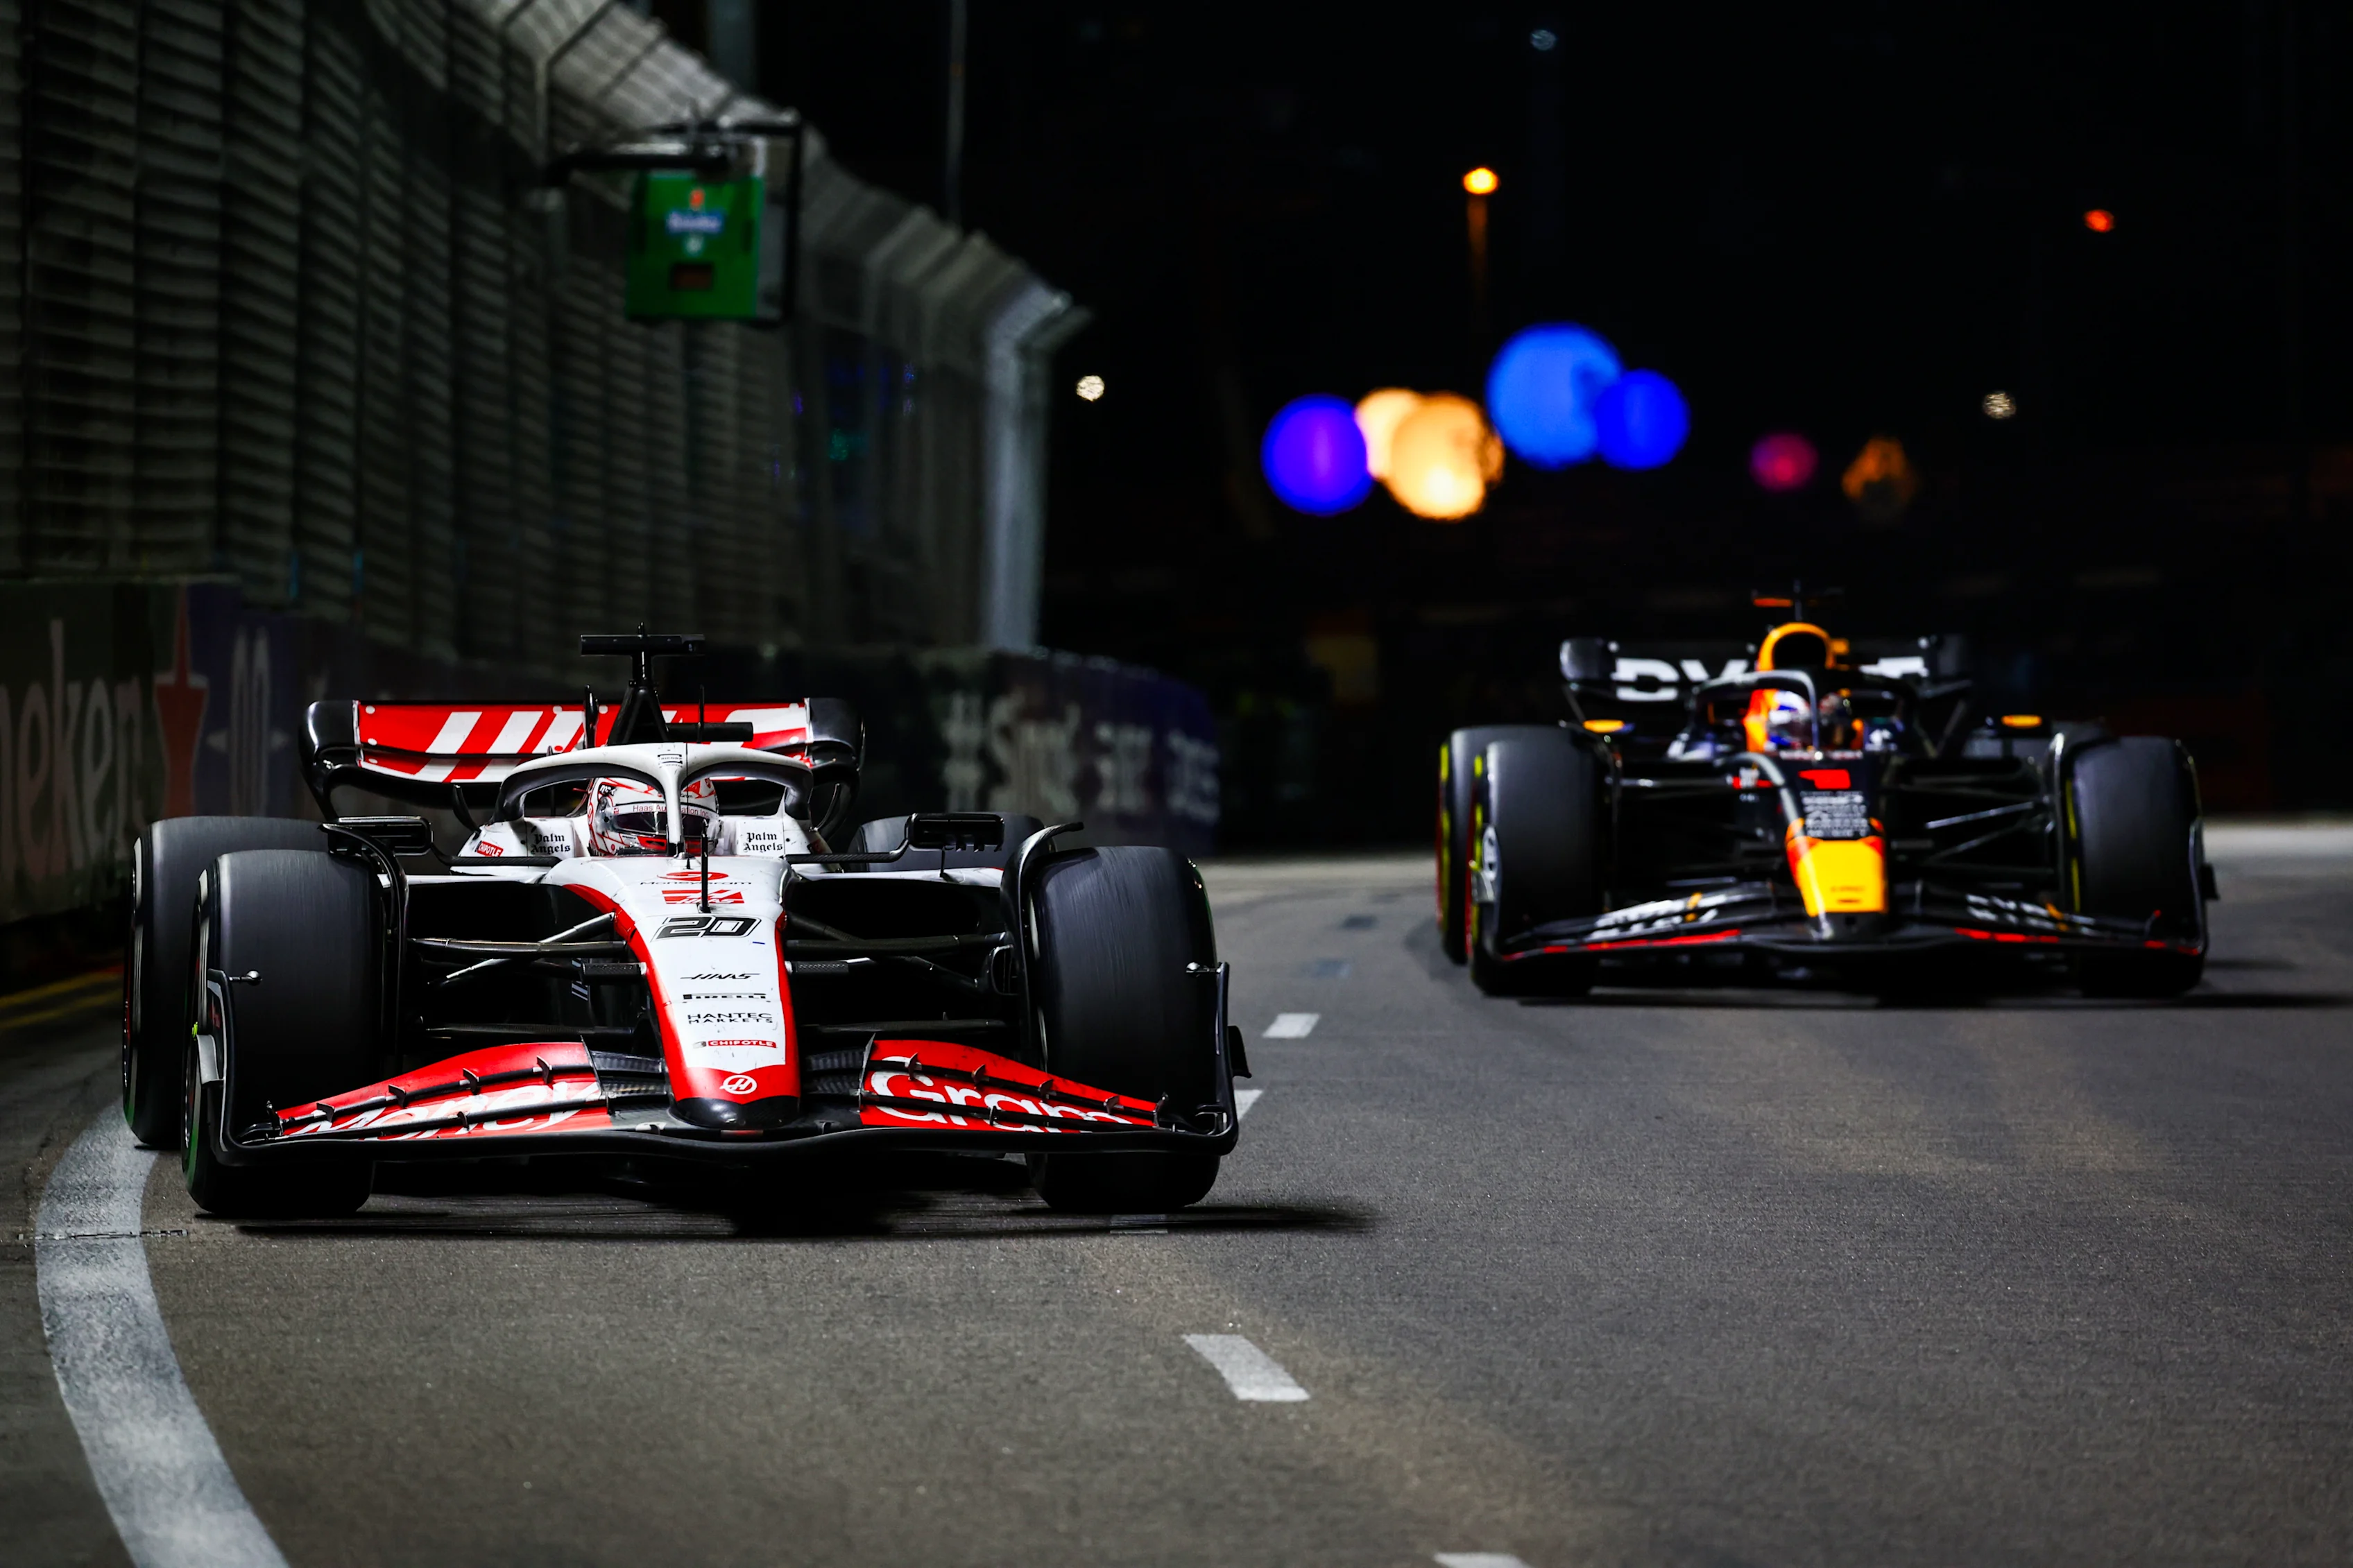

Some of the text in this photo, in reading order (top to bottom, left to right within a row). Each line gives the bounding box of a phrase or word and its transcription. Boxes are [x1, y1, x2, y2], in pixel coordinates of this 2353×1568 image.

[533, 833, 565, 844] Palm
[746, 832, 778, 843] Palm
[477, 841, 502, 857] CHIPOTLE
[530, 843, 571, 855] Angels
[743, 842, 783, 853] Angels
[650, 916, 762, 942] 20
